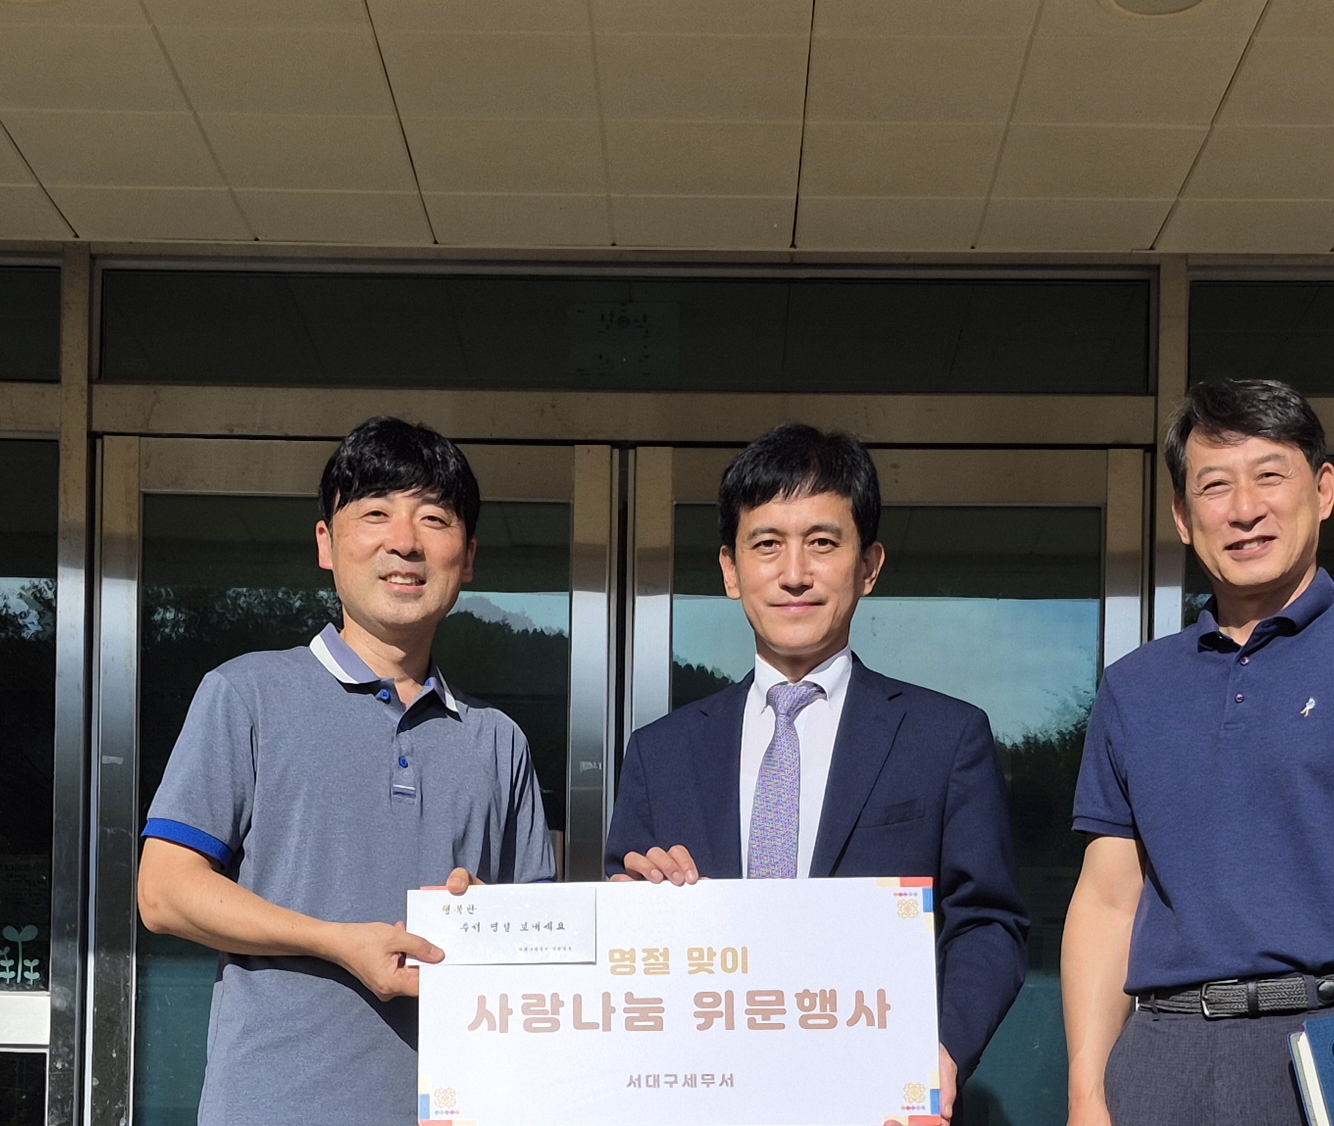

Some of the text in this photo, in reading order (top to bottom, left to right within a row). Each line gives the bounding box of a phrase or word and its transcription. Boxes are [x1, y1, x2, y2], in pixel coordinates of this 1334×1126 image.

[608, 946, 750, 976] 명절 맞이
[467, 988, 892, 1034] 사랑나눔 위문행사
[626, 1071, 736, 1089] 서대구세무서
